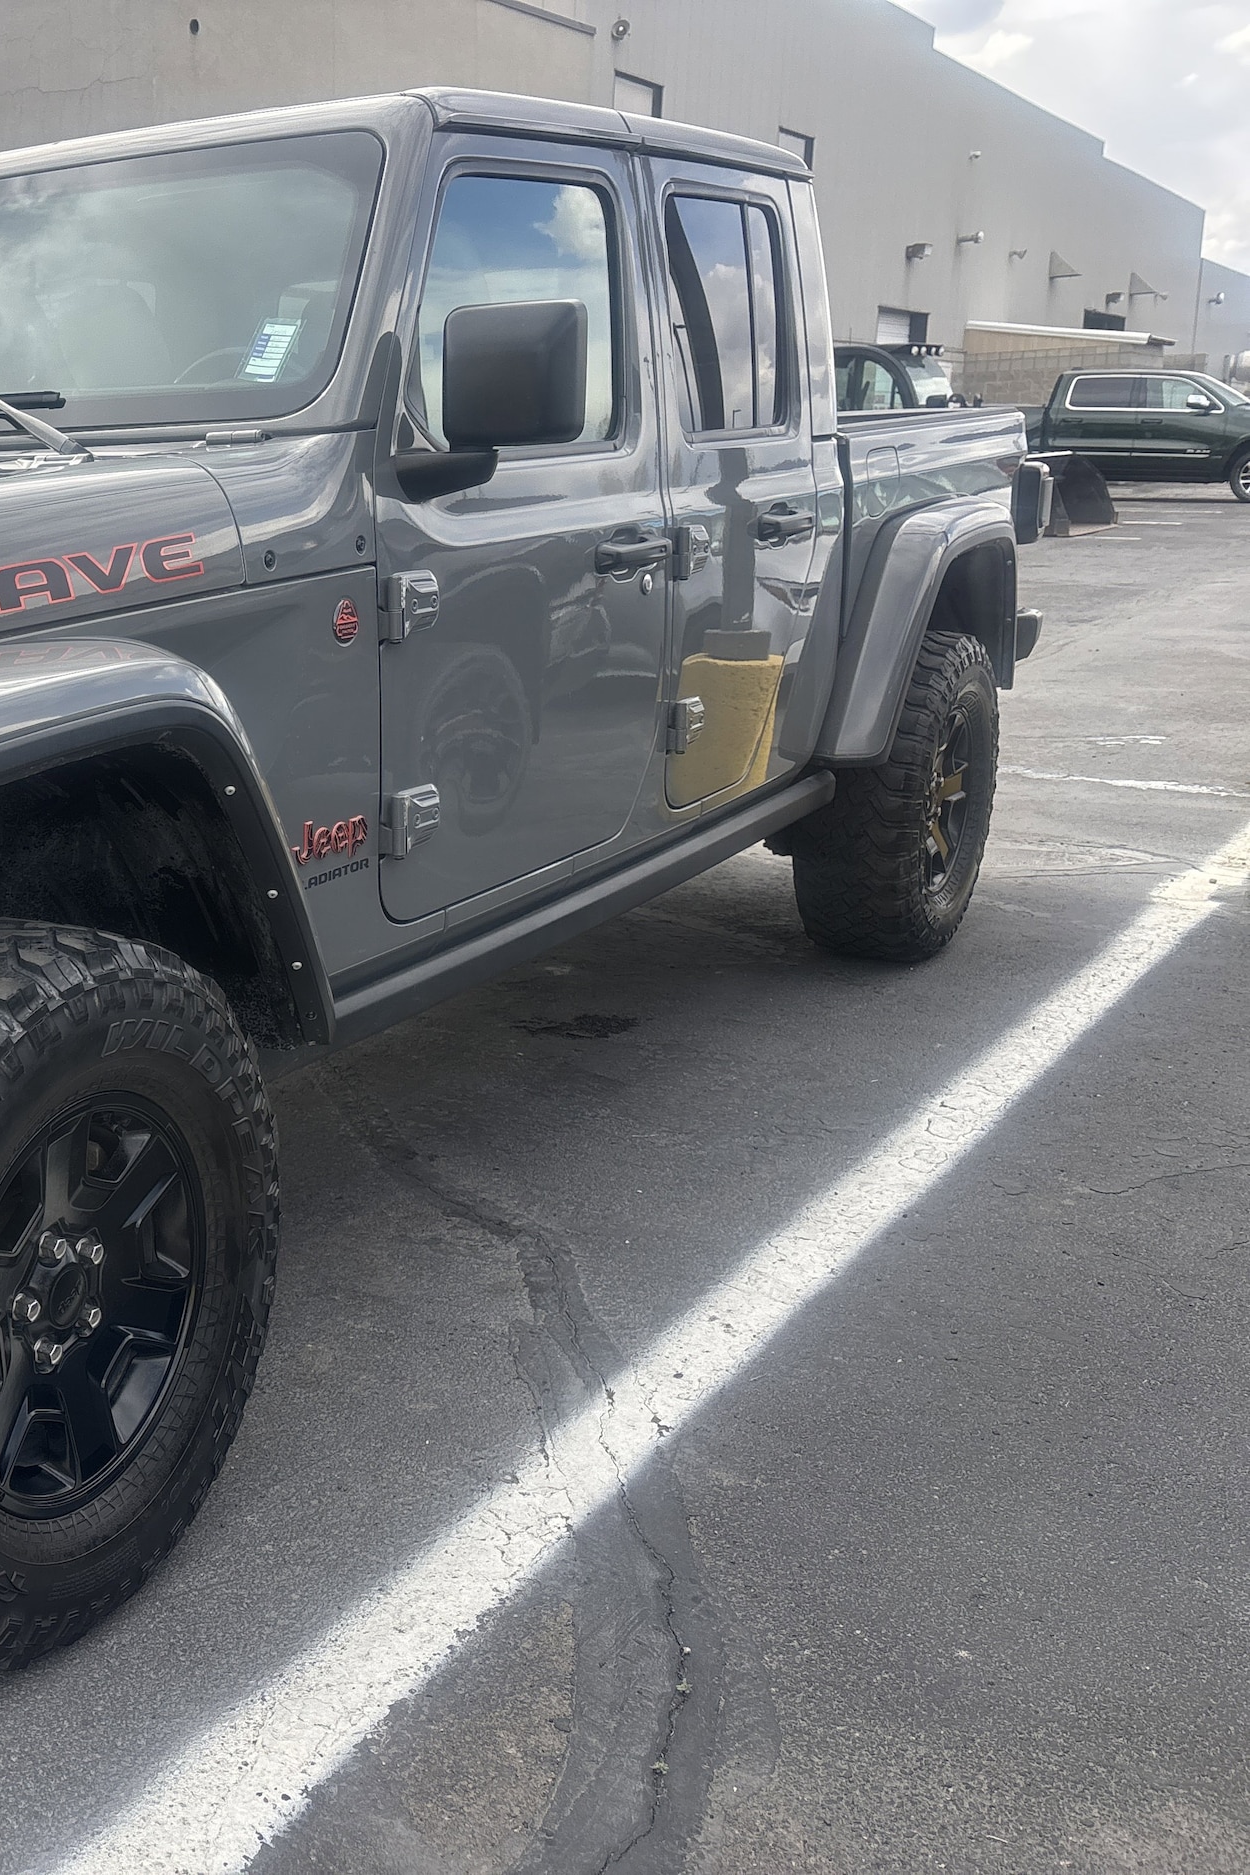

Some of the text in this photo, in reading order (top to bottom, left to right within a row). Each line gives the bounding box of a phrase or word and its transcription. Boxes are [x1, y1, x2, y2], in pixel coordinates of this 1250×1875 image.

[291, 814, 368, 865] Jeep
[304, 858, 370, 890] ADIATOR
[101, 1018, 265, 1262] WILDPEAK
